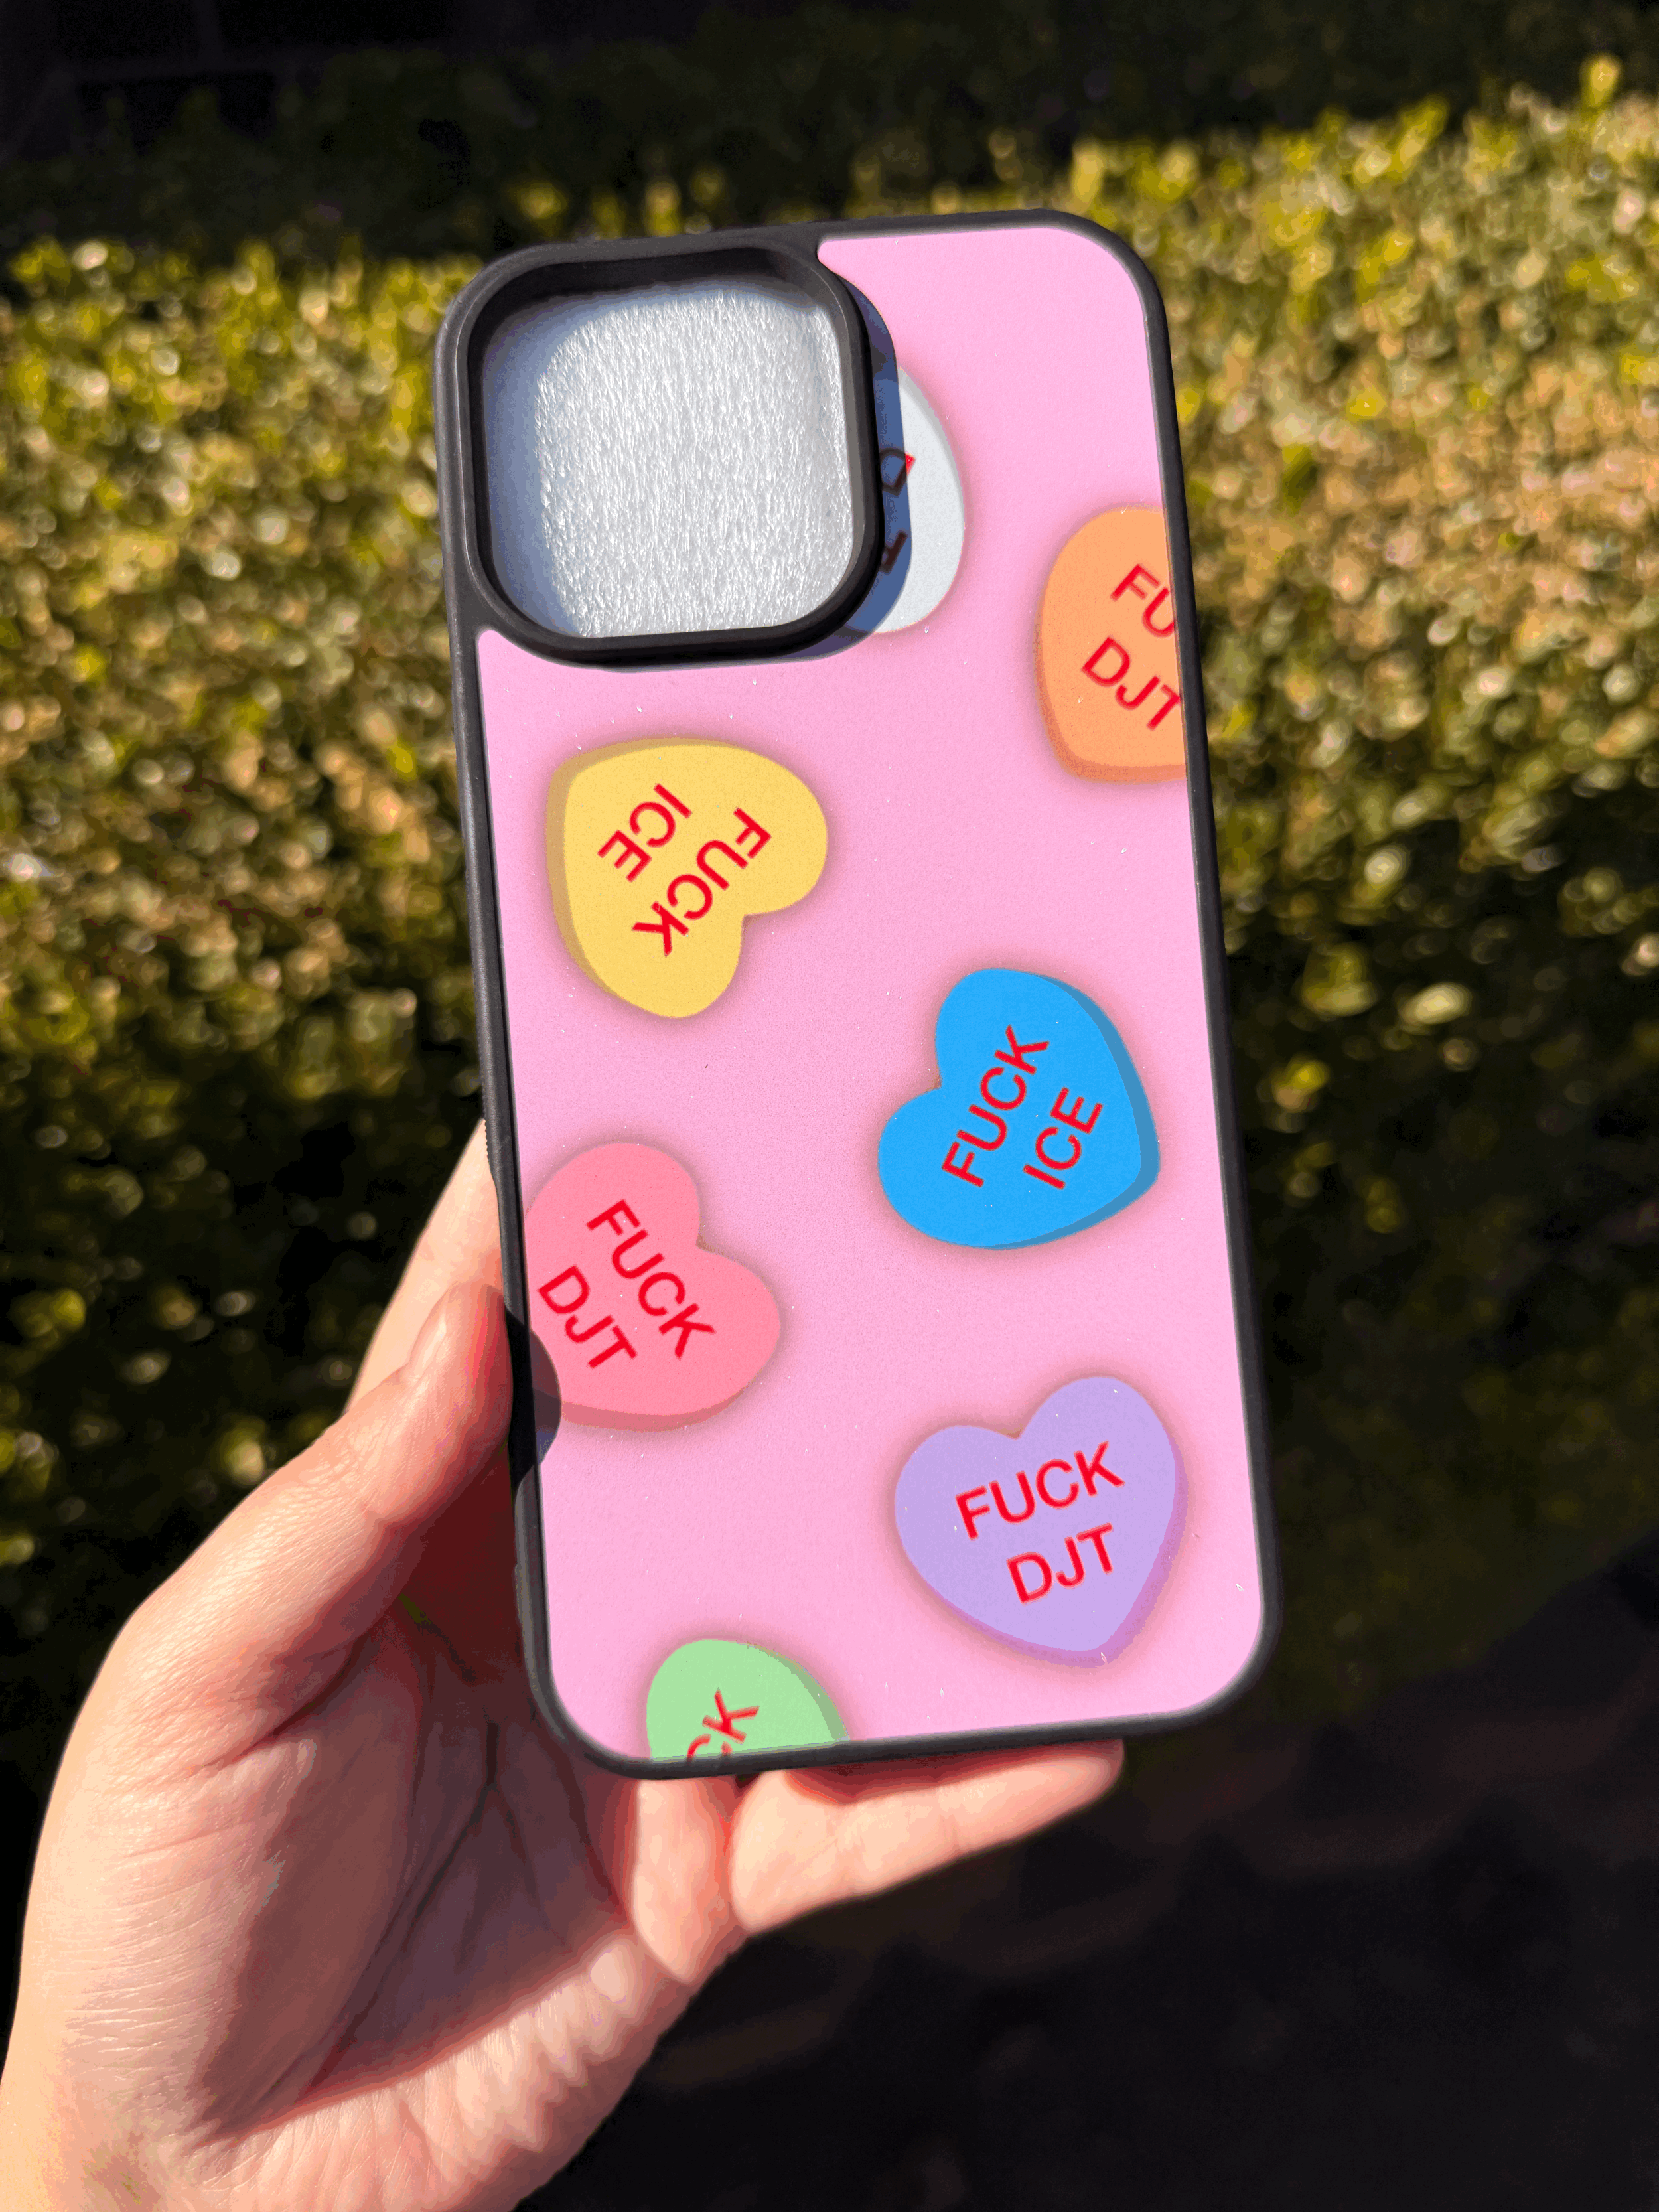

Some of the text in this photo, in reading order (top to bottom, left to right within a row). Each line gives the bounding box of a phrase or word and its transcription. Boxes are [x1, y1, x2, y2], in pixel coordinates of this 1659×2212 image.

[1080, 635, 1183, 731] DJT
[596, 782, 693, 883] ICE
[630, 806, 772, 958] FUCK
[940, 1025, 1050, 1189] FUCK
[1023, 1087, 1104, 1190] ICE
[536, 1263, 639, 1371] DJT
[585, 1197, 717, 1361] FUCK
[954, 1441, 1125, 1540] FUCK
[1006, 1522, 1115, 1605] DJT
